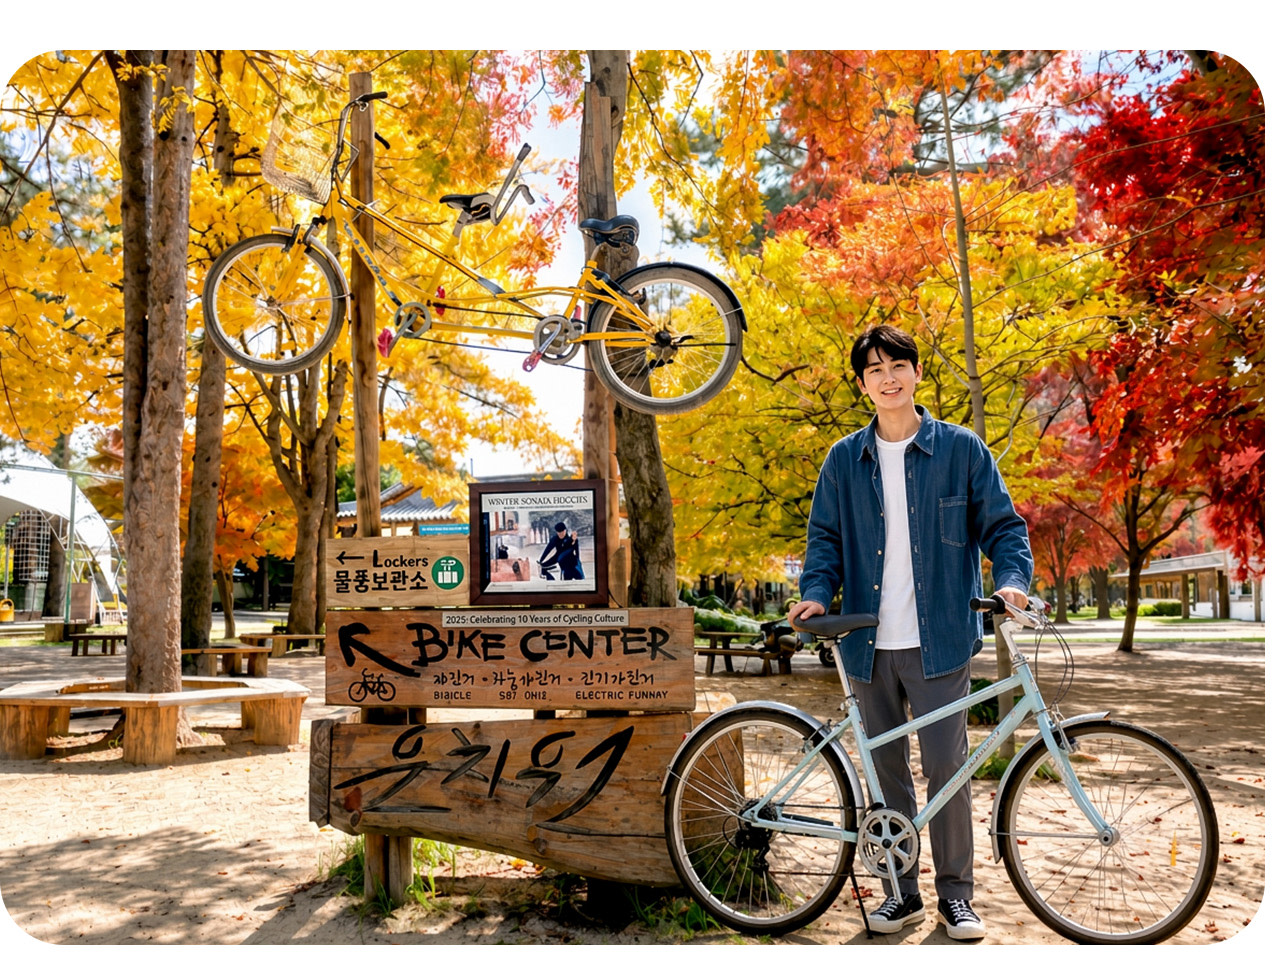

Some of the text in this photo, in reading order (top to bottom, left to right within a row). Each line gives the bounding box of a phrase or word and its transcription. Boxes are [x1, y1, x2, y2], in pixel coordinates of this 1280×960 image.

[372, 549, 429, 568] Lockers
[446, 615, 469, 624] 2025:
[470, 615, 516, 625] Celebrating
[519, 615, 528, 623] 10
[529, 614, 551, 623] Years
[553, 614, 562, 623] of
[563, 614, 593, 625] Cycling
[406, 622, 678, 667] BIKE CENTER
